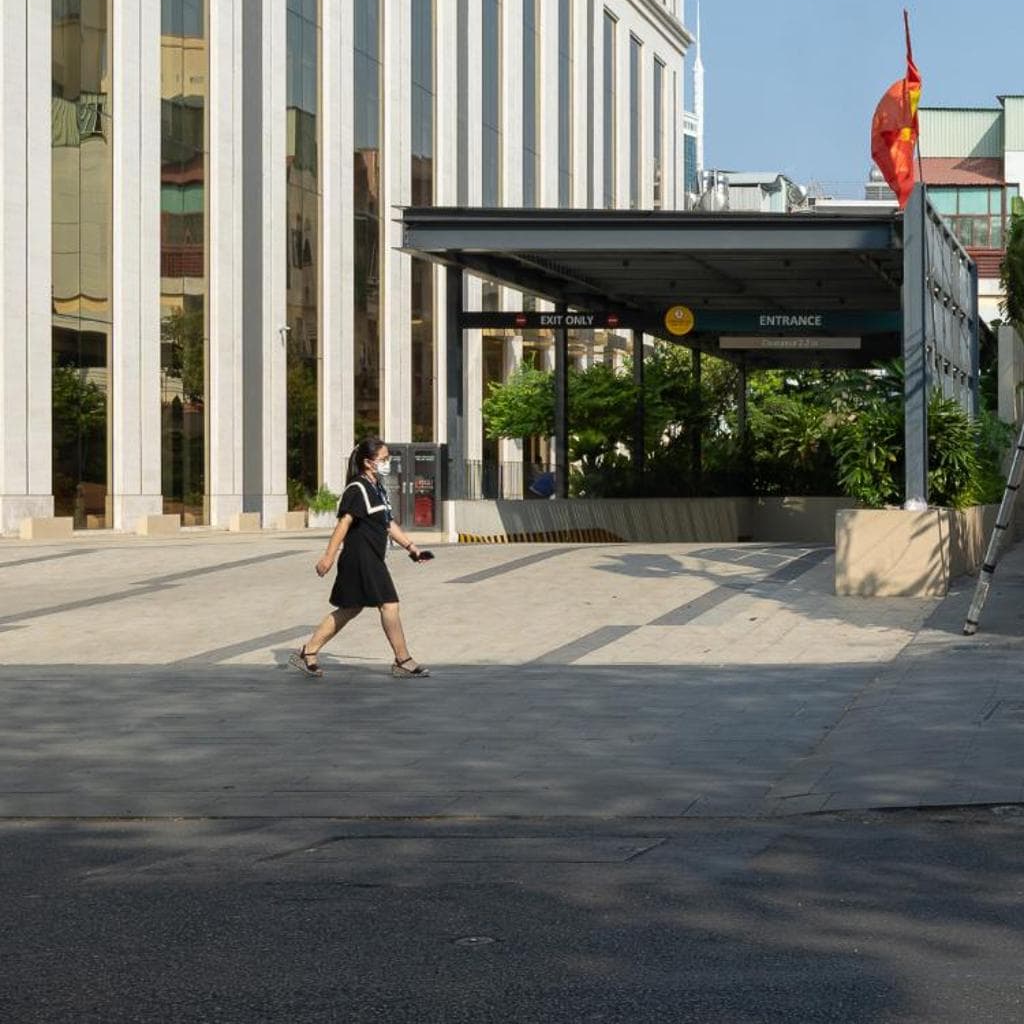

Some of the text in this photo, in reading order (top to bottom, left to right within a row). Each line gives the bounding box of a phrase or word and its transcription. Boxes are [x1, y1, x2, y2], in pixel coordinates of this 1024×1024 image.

[540, 314, 594, 326] EXIT ONLY
[759, 315, 822, 326] ENTRANCE
